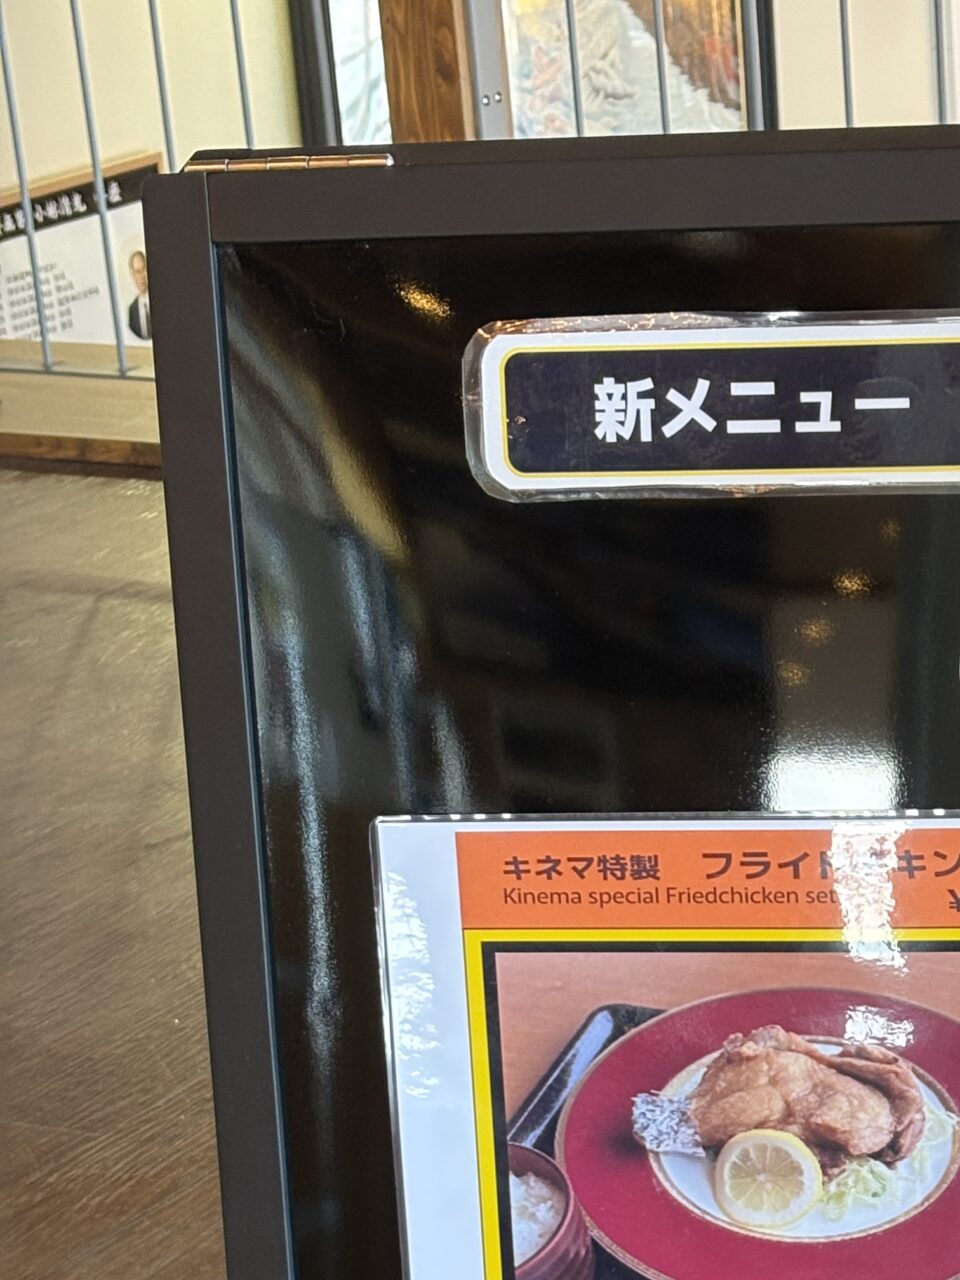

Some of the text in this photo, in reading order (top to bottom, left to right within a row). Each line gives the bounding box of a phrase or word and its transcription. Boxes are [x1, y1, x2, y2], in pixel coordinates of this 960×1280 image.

[593, 376, 911, 443] 新メニュー
[503, 853, 661, 882] キネマ特製
[503, 885, 837, 909] Kinema special Friedchicken set
